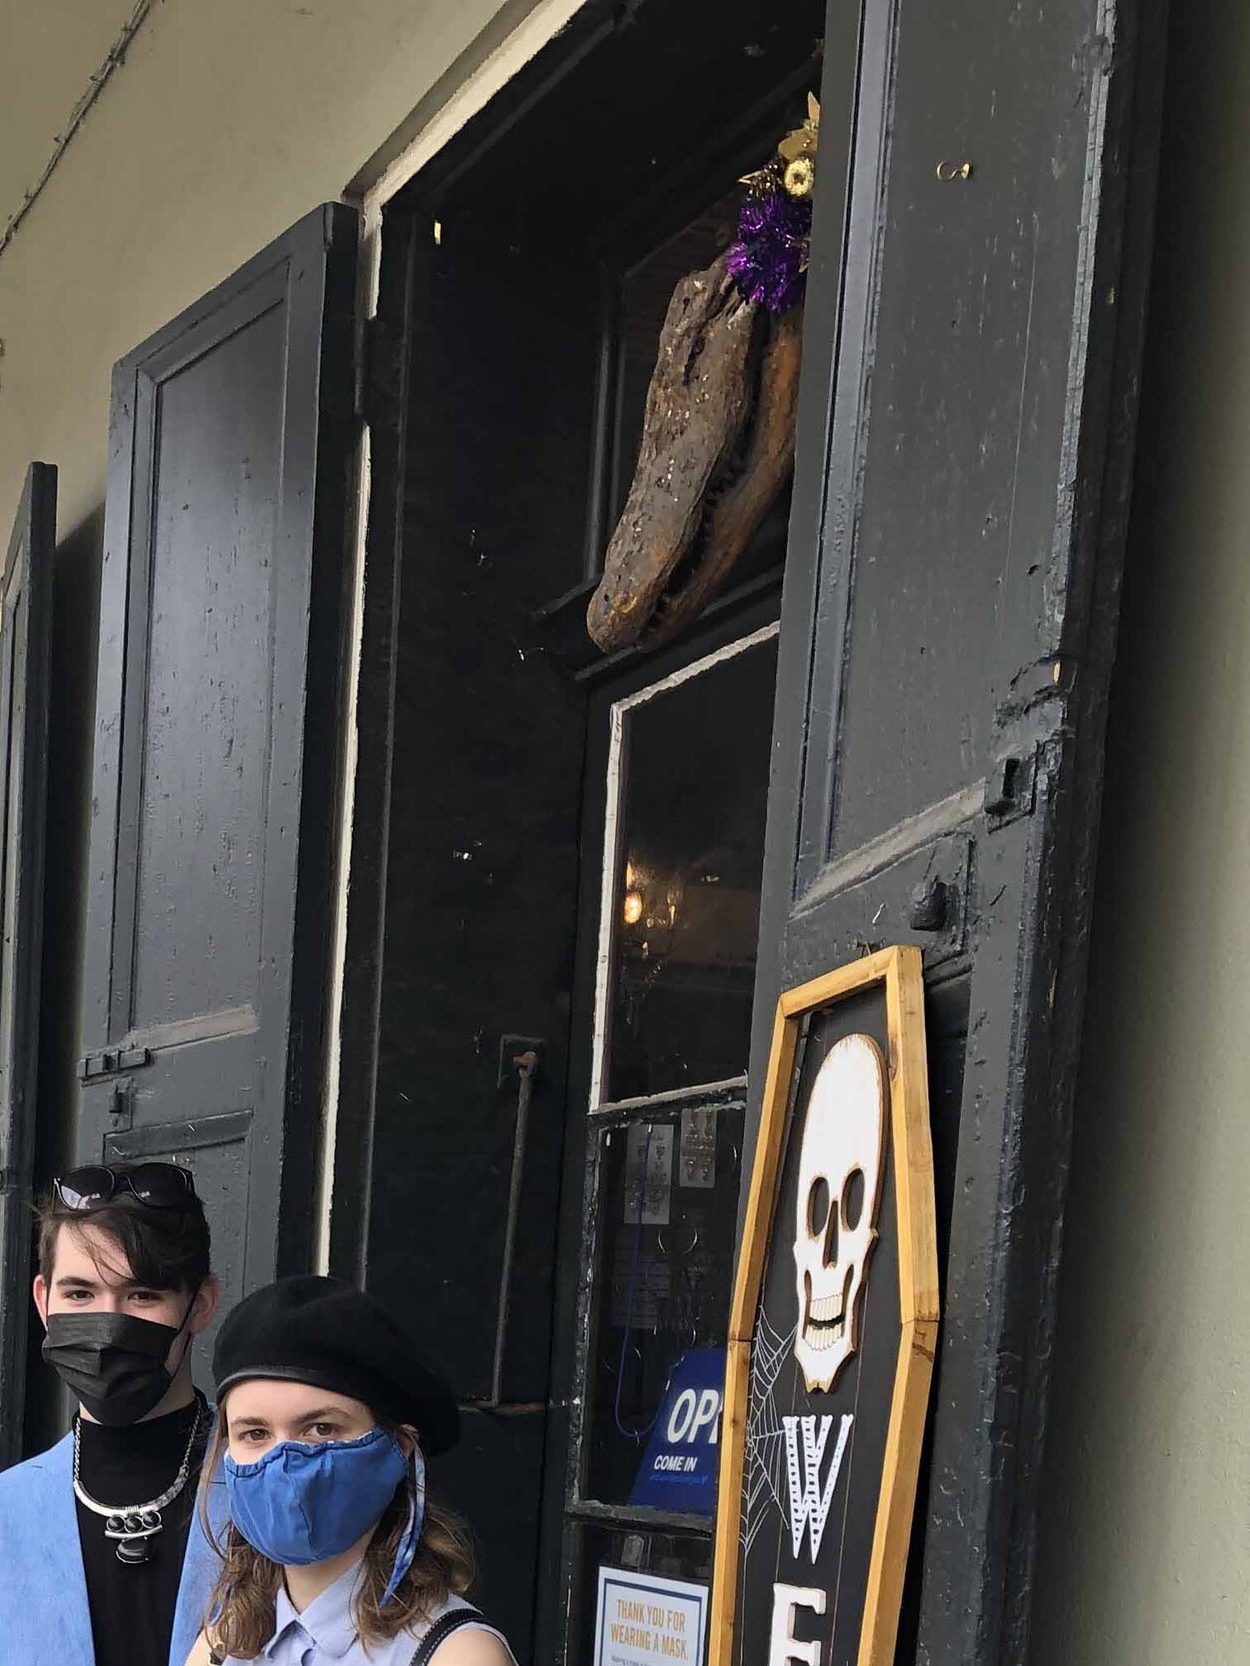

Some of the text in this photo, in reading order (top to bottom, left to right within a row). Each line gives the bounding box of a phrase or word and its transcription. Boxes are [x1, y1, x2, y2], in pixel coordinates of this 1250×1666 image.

[654, 1455, 698, 1472] COME IN
[617, 1599, 686, 1634] THANK YOU FOR
[610, 1623, 651, 1651] WEARING
[653, 1633, 659, 1654] A
